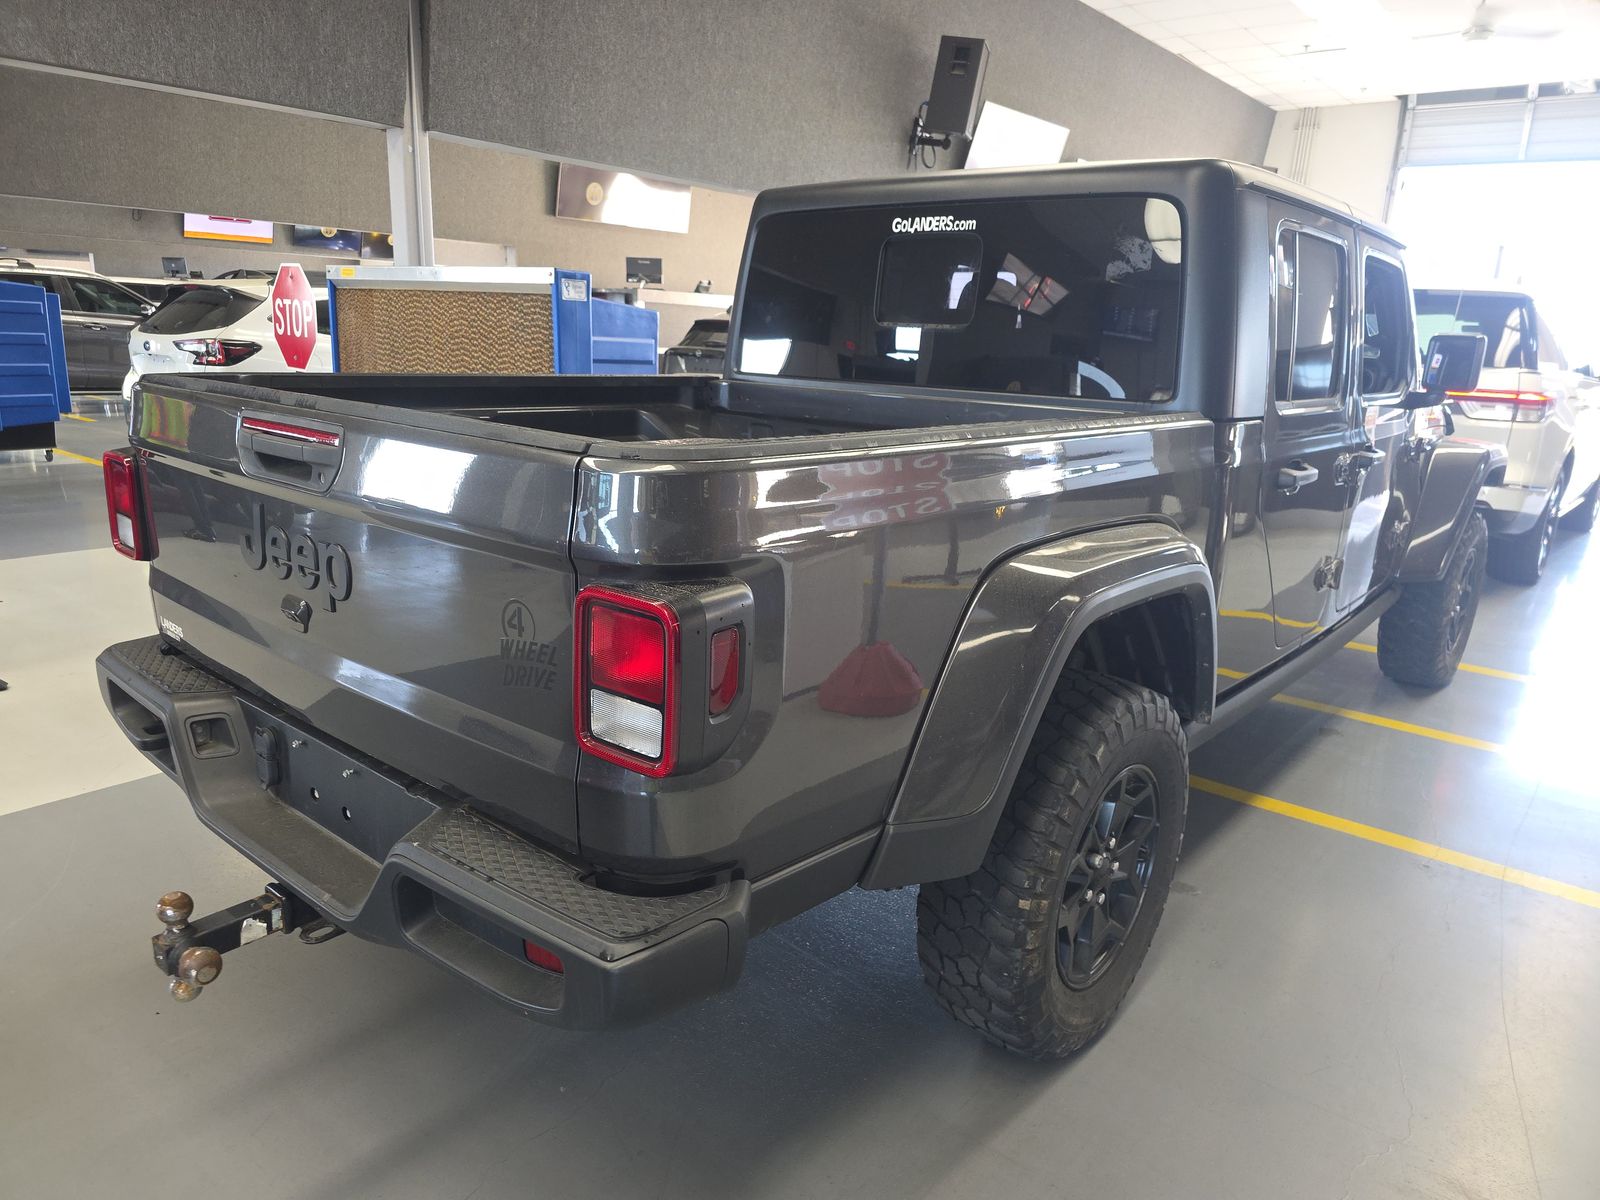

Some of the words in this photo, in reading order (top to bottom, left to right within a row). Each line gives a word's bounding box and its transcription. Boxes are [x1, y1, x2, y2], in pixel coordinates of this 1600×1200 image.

[892, 215, 976, 234] GoLANDERS.com
[275, 298, 312, 338] STOP
[240, 503, 353, 613] Jeep
[507, 606, 525, 638] 4
[500, 638, 558, 667] WHEEL
[503, 663, 557, 691] DRIVE
